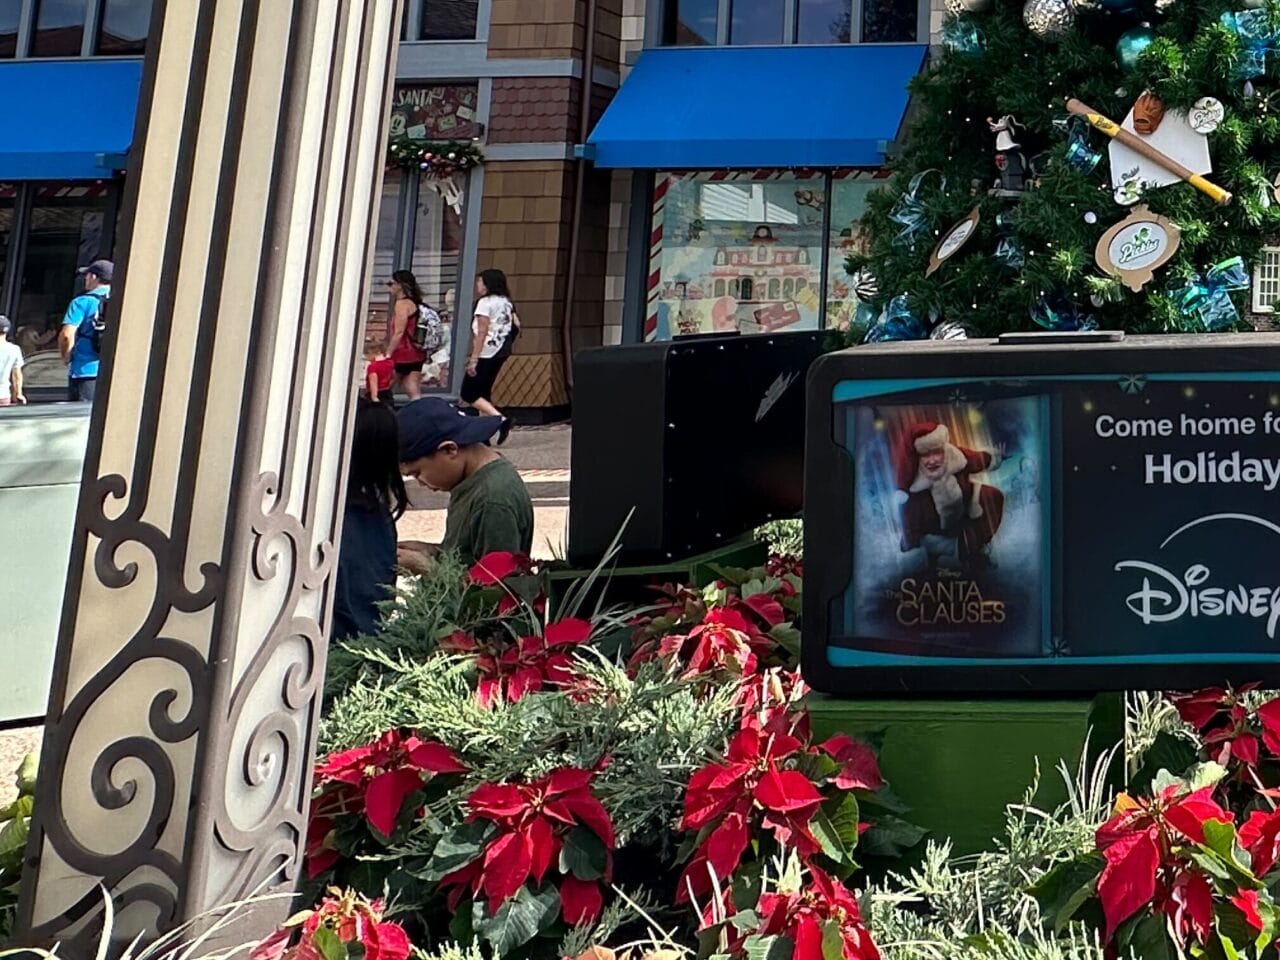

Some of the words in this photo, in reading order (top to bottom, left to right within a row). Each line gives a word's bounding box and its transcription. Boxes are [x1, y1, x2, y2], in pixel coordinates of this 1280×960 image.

[398, 88, 432, 107] SANTA
[1095, 415, 1173, 437] Come
[1181, 413, 1256, 436] home
[901, 578, 983, 602] SANTA
[896, 600, 1007, 625] CLAUSES
